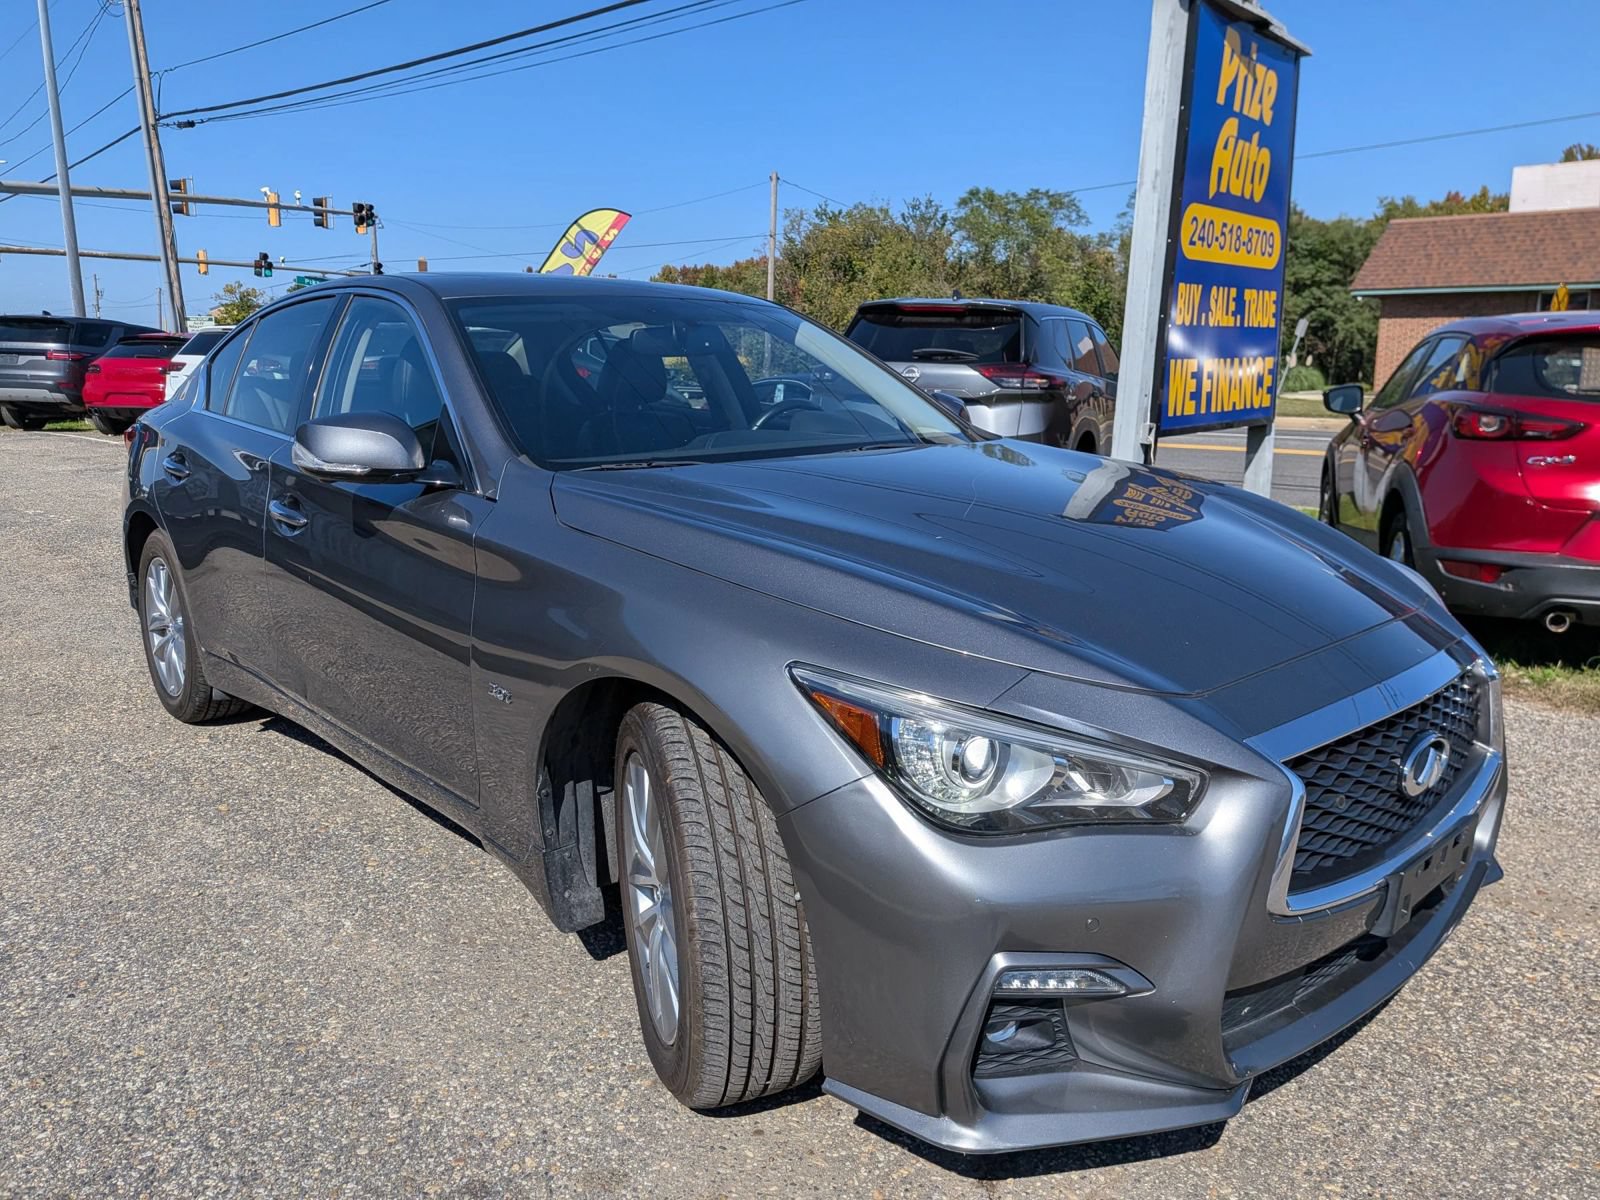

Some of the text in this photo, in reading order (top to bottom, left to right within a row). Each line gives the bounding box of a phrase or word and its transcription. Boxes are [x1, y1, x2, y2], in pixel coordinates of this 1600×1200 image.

[1216, 25, 1278, 127] Prize
[1209, 117, 1271, 203] Auto
[1188, 216, 1275, 258] 240-518-8709
[1244, 289, 1277, 328] TRADE
[1168, 356, 1275, 417] WE FINANCE
